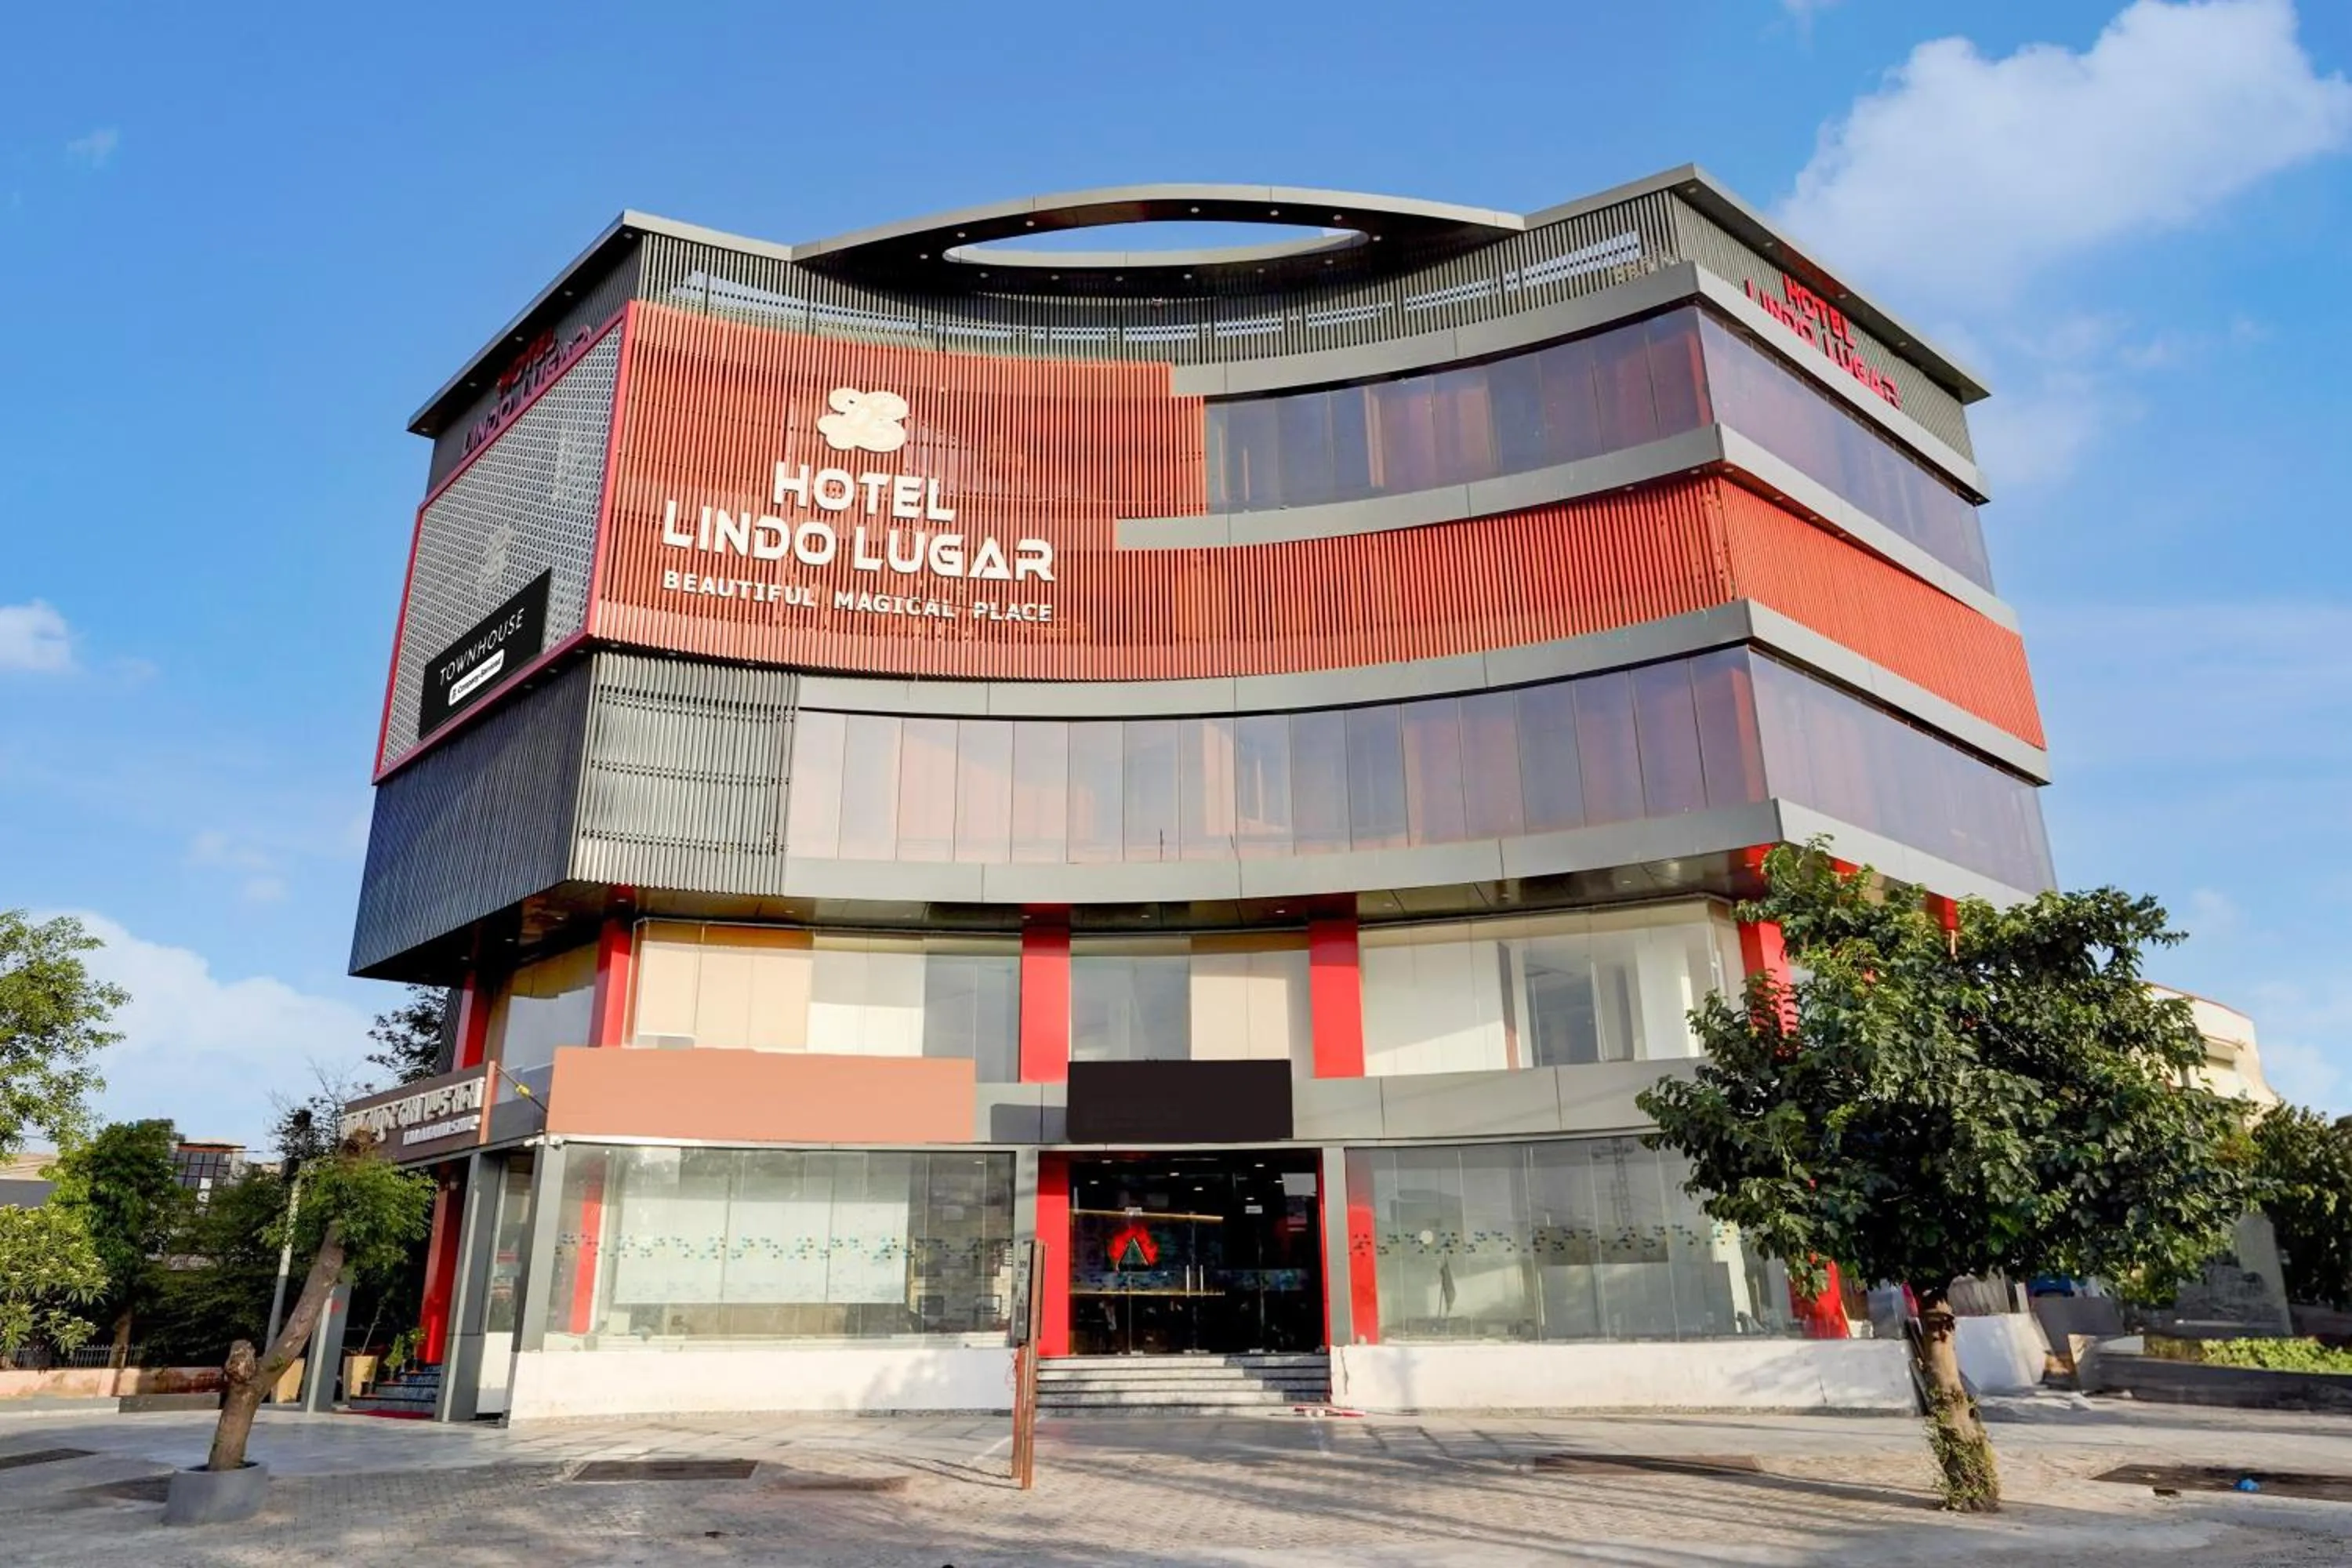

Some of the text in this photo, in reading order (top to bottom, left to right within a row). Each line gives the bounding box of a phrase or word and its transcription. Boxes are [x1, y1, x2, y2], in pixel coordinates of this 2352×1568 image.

[1744, 277, 1902, 410] LINDO LUGAR
[1781, 273, 1857, 349] HOTEL
[773, 461, 956, 522] HOTEL
[662, 499, 1055, 582] LINDO LUGAR
[662, 570, 1054, 622] BEAUTIFUL MAGICAL PLACE
[440, 608, 525, 687] TOWNHOUSE
